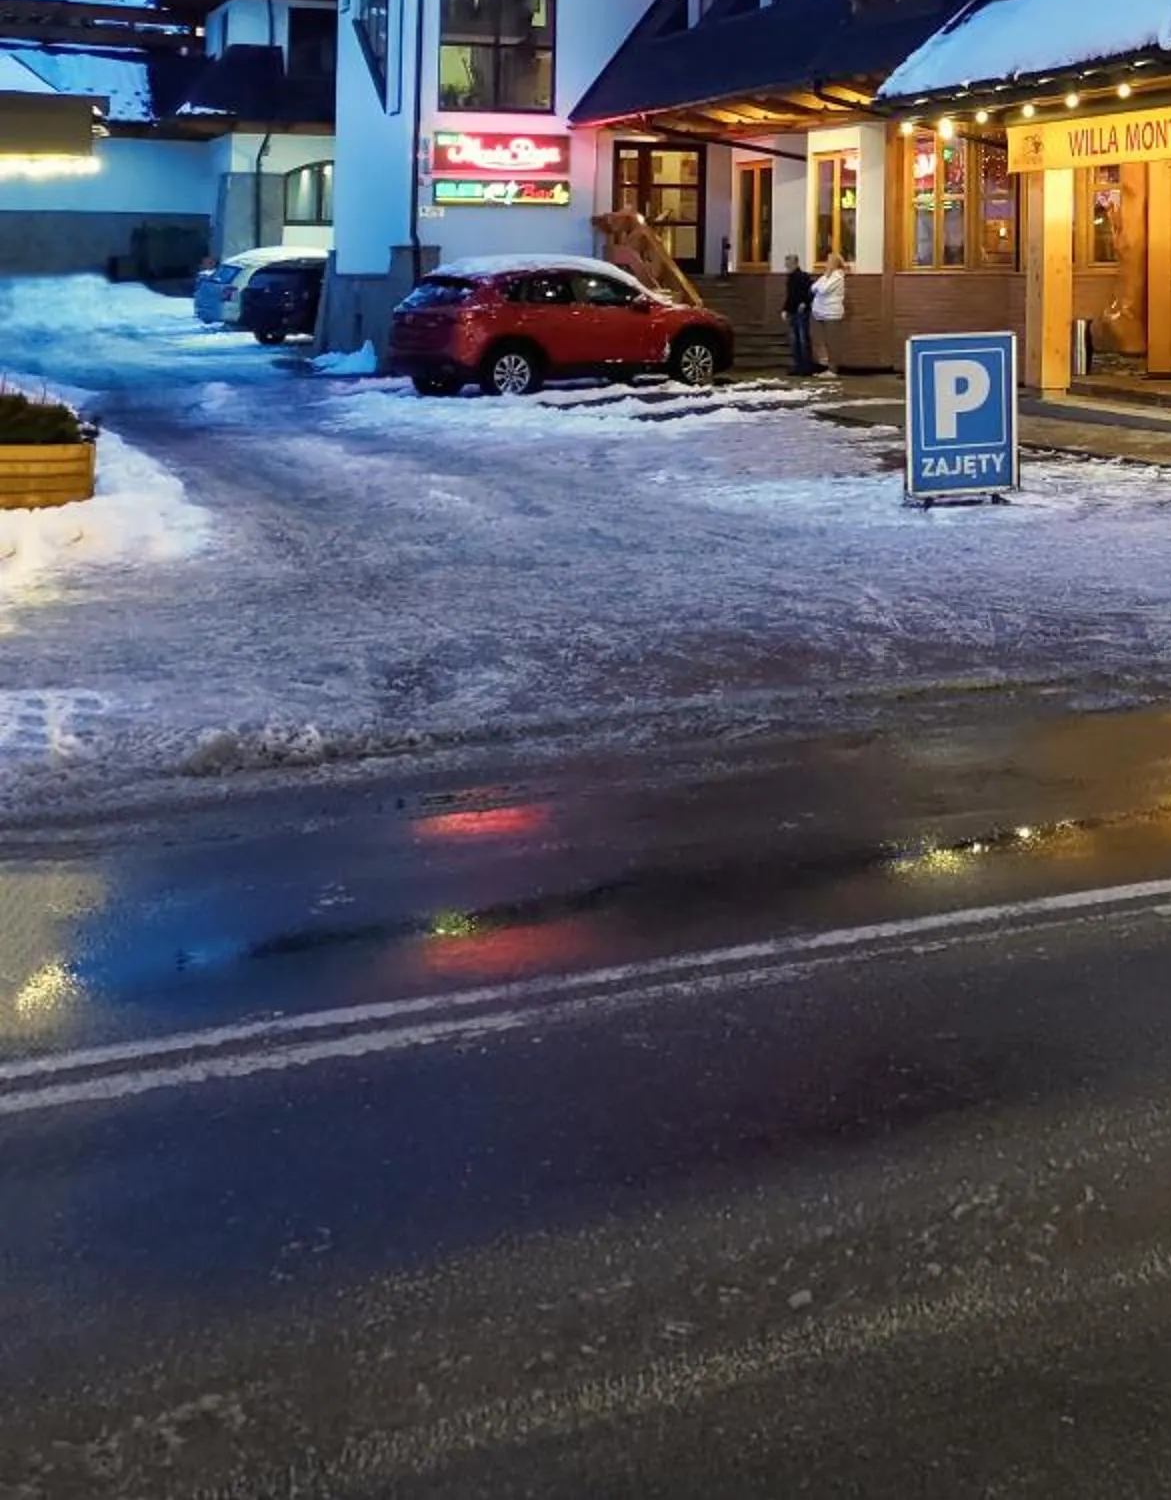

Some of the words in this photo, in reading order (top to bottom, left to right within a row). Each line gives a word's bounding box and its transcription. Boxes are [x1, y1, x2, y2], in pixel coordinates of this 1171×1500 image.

[1067, 124, 1119, 157] WILLA
[933, 360, 991, 439] P
[921, 453, 1006, 479] ZAJĘTY
